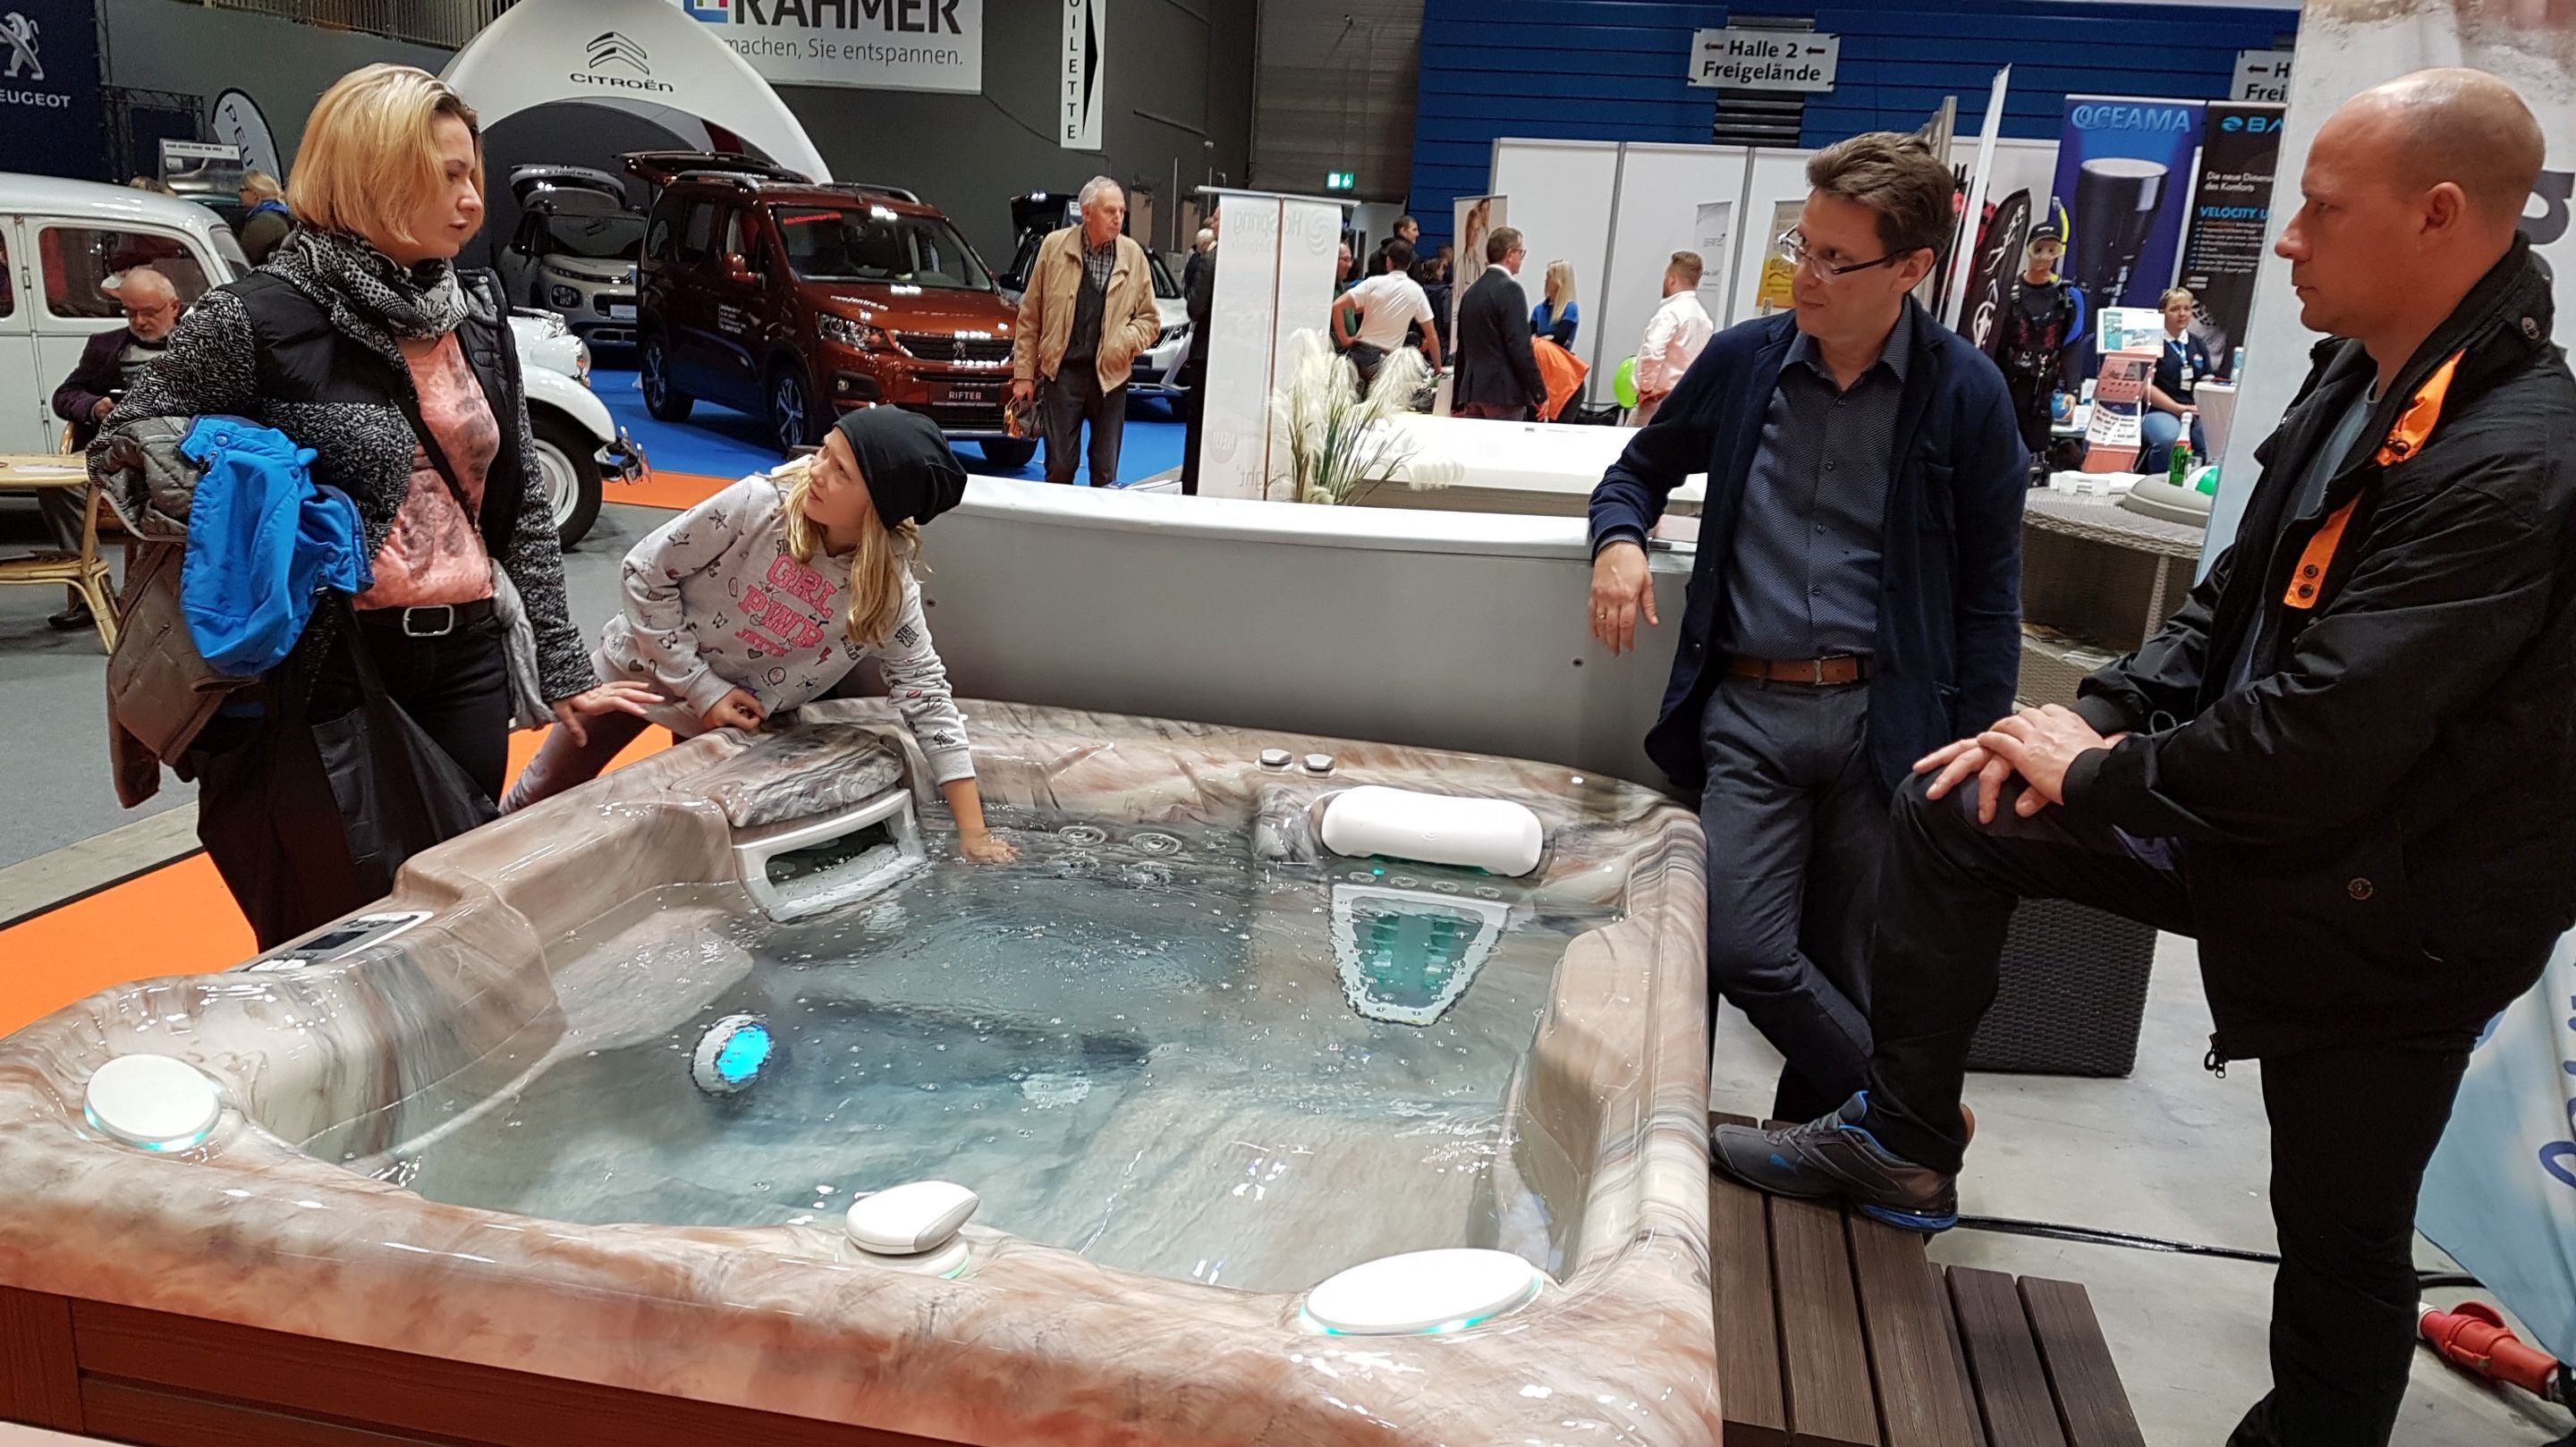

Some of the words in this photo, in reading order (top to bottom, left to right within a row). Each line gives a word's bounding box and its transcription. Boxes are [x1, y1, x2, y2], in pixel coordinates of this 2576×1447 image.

[808, 38, 836, 59] Sie
[843, 43, 963, 67] entspannen.
[1729, 39, 1779, 57] Halle
[1785, 43, 1799, 58] 2
[1703, 61, 1821, 84] Freigelände
[2072, 105, 2190, 132] OCEAMA
[2200, 206, 2258, 219] VELOCITY
[948, 391, 982, 401] RIFTER
[767, 554, 838, 619] GRL
